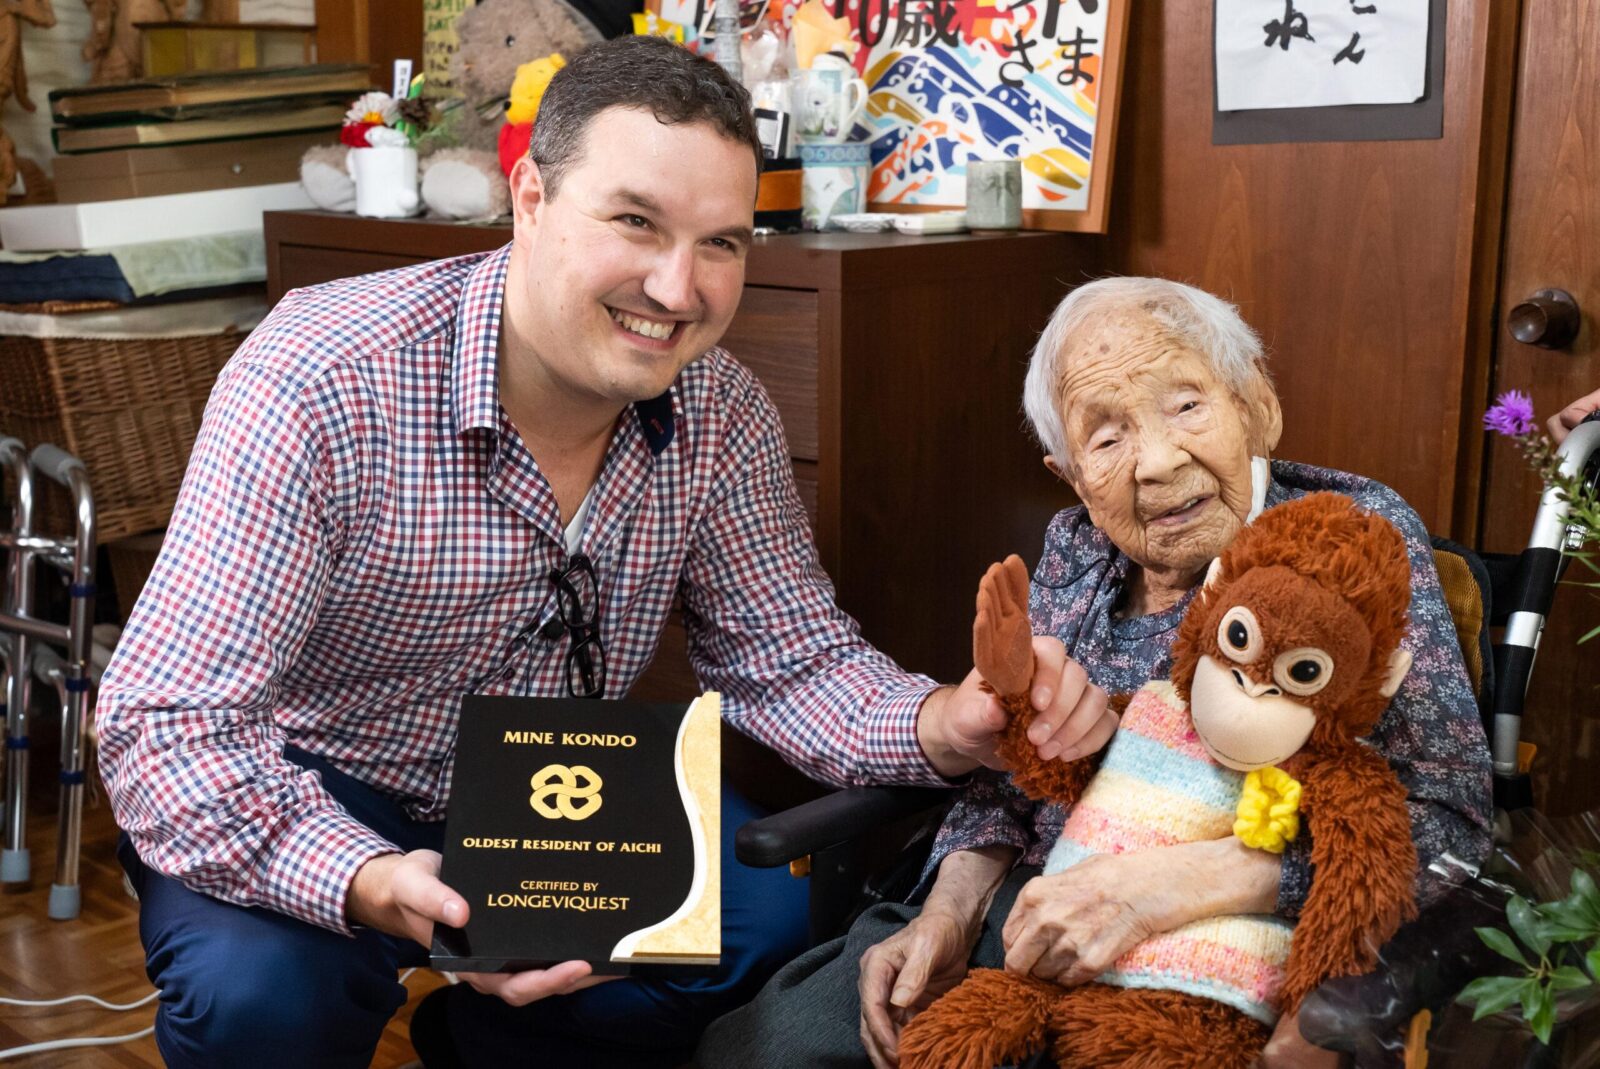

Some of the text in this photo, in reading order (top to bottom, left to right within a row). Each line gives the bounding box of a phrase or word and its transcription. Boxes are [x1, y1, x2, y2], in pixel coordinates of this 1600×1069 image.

[999, 26, 1099, 88] さま
[503, 730, 637, 748] MINE KONDO
[462, 837, 662, 854] OLDEST RESIDENT OF AICHI
[520, 880, 599, 892] CERTIFIED BY
[487, 893, 630, 913] LONGEVIQUEST
